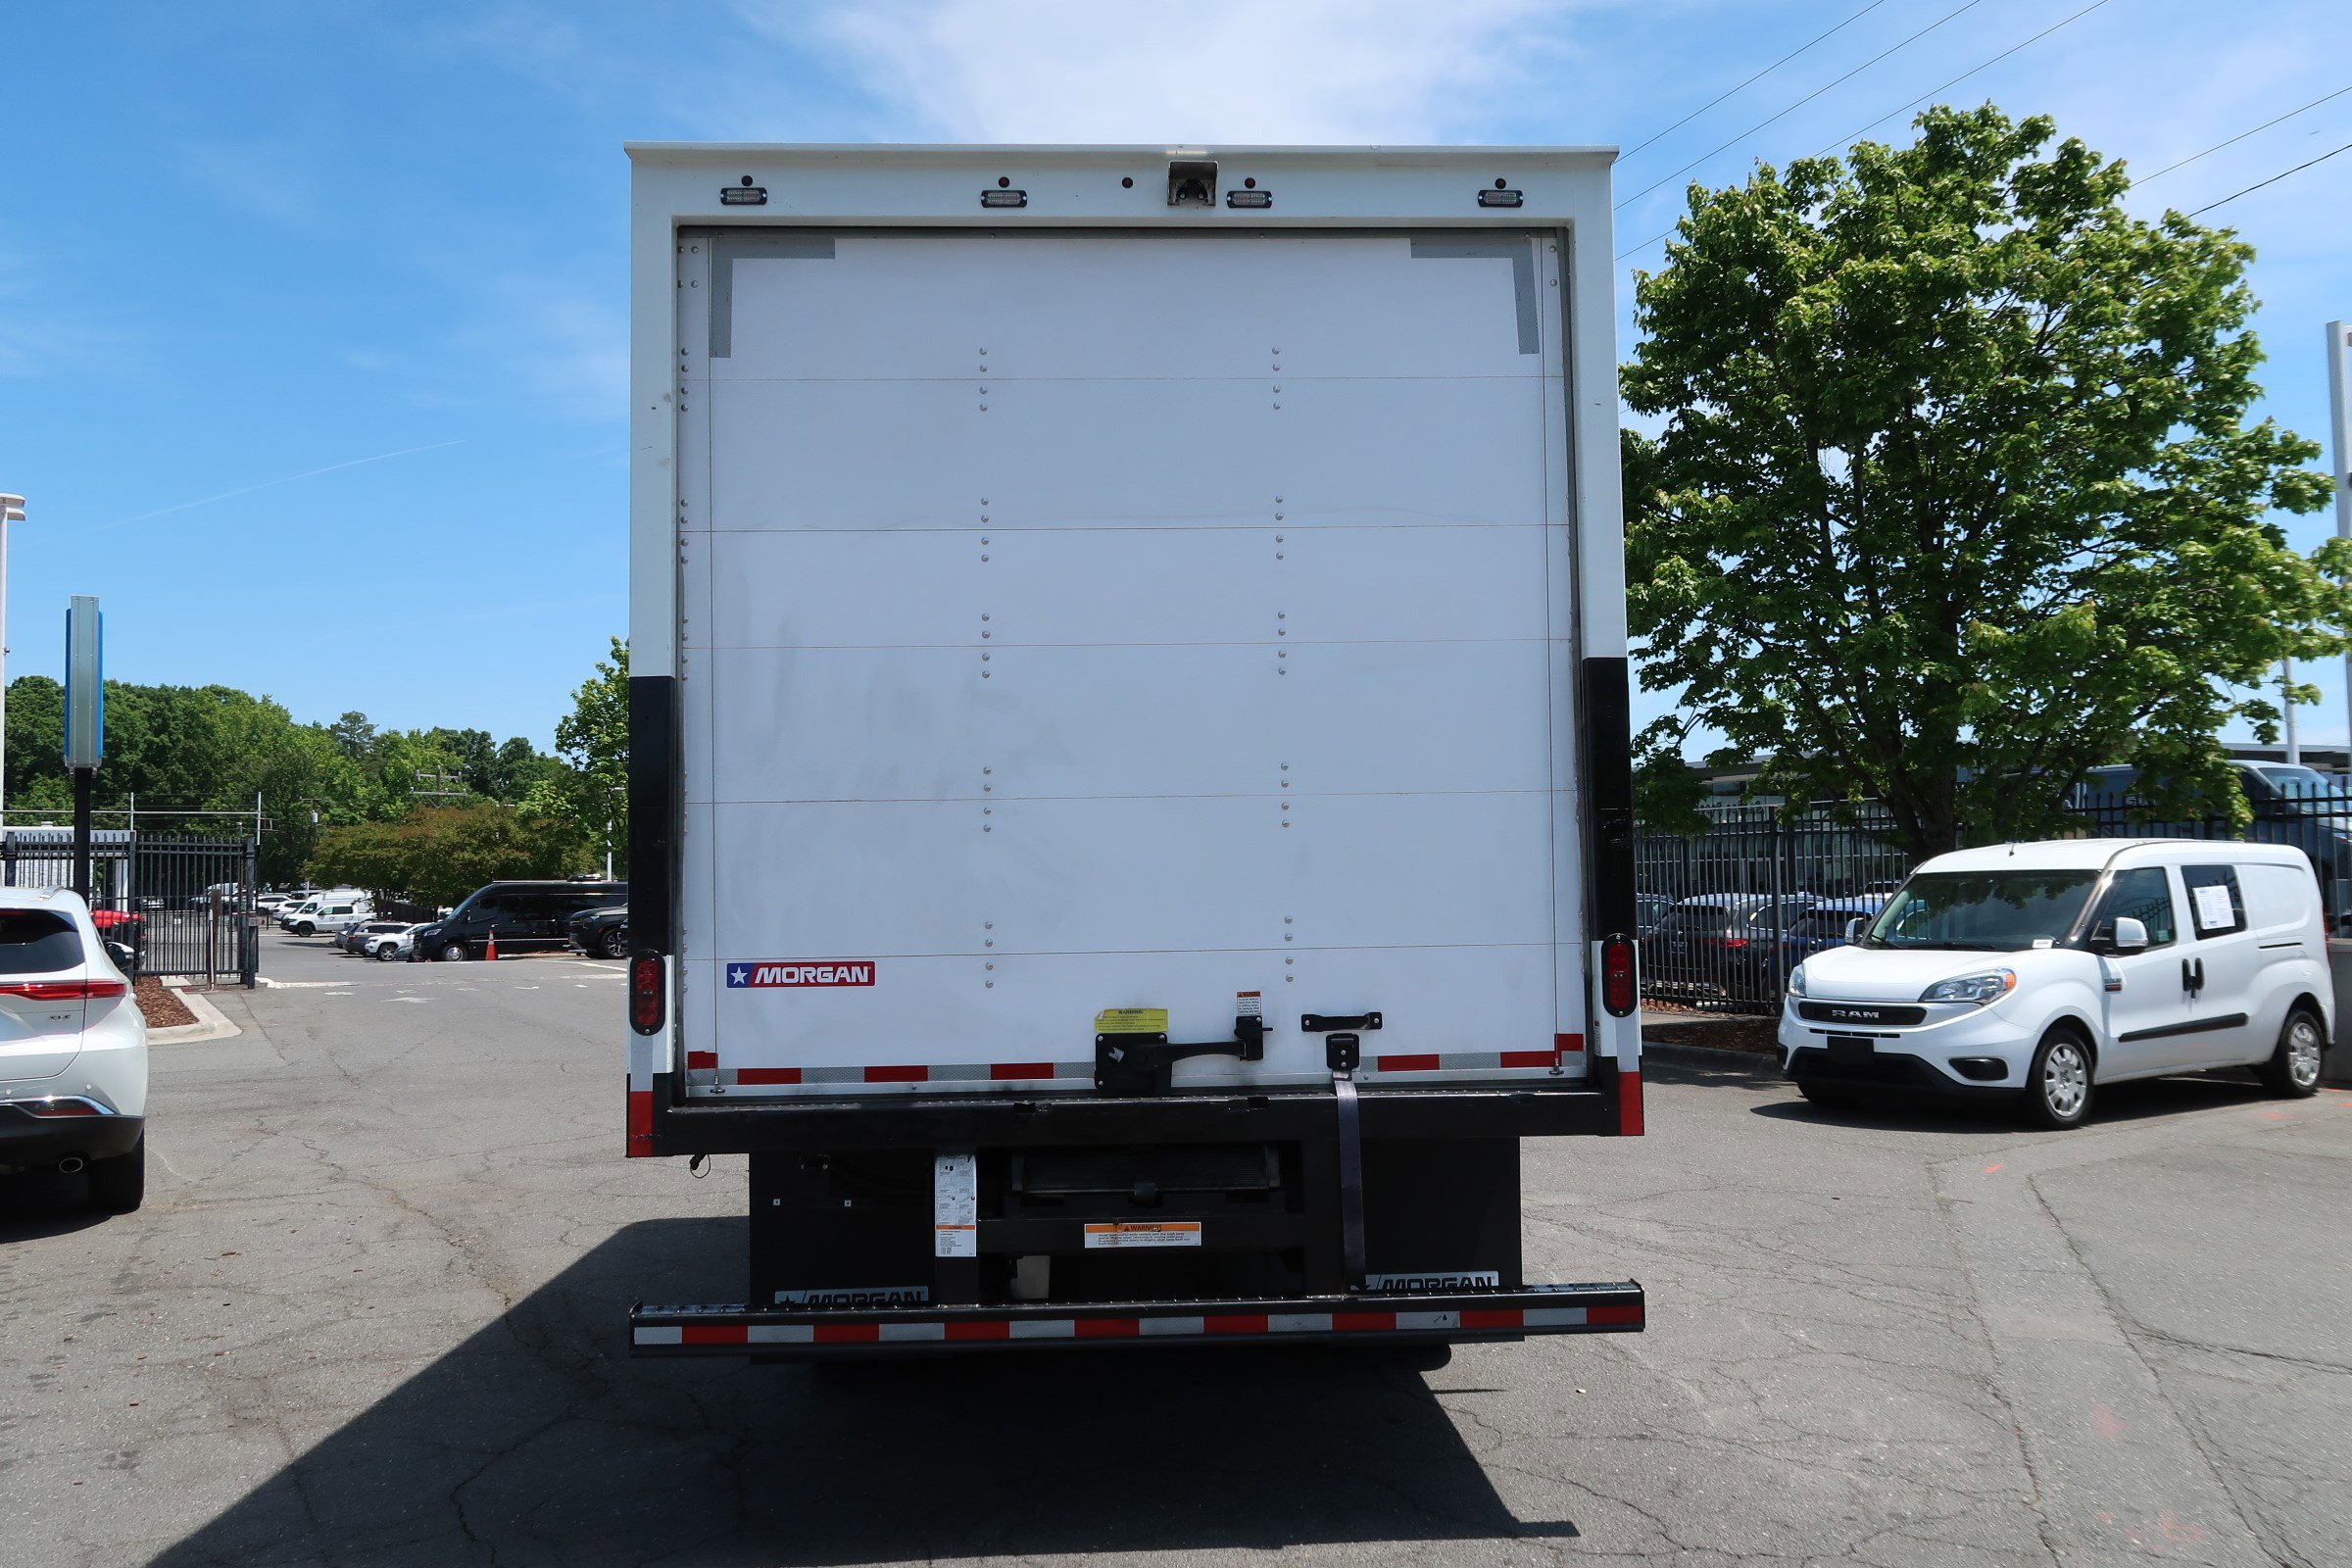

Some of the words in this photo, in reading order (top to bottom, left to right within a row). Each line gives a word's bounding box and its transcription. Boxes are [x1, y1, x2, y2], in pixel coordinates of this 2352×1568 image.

[755, 966, 869, 984] MORGAN
[1832, 1009, 1880, 1018] RAM
[1130, 1224, 1162, 1233] WARNING
[1382, 1276, 1492, 1291] MORGAN
[808, 1291, 921, 1303] MORGAN
